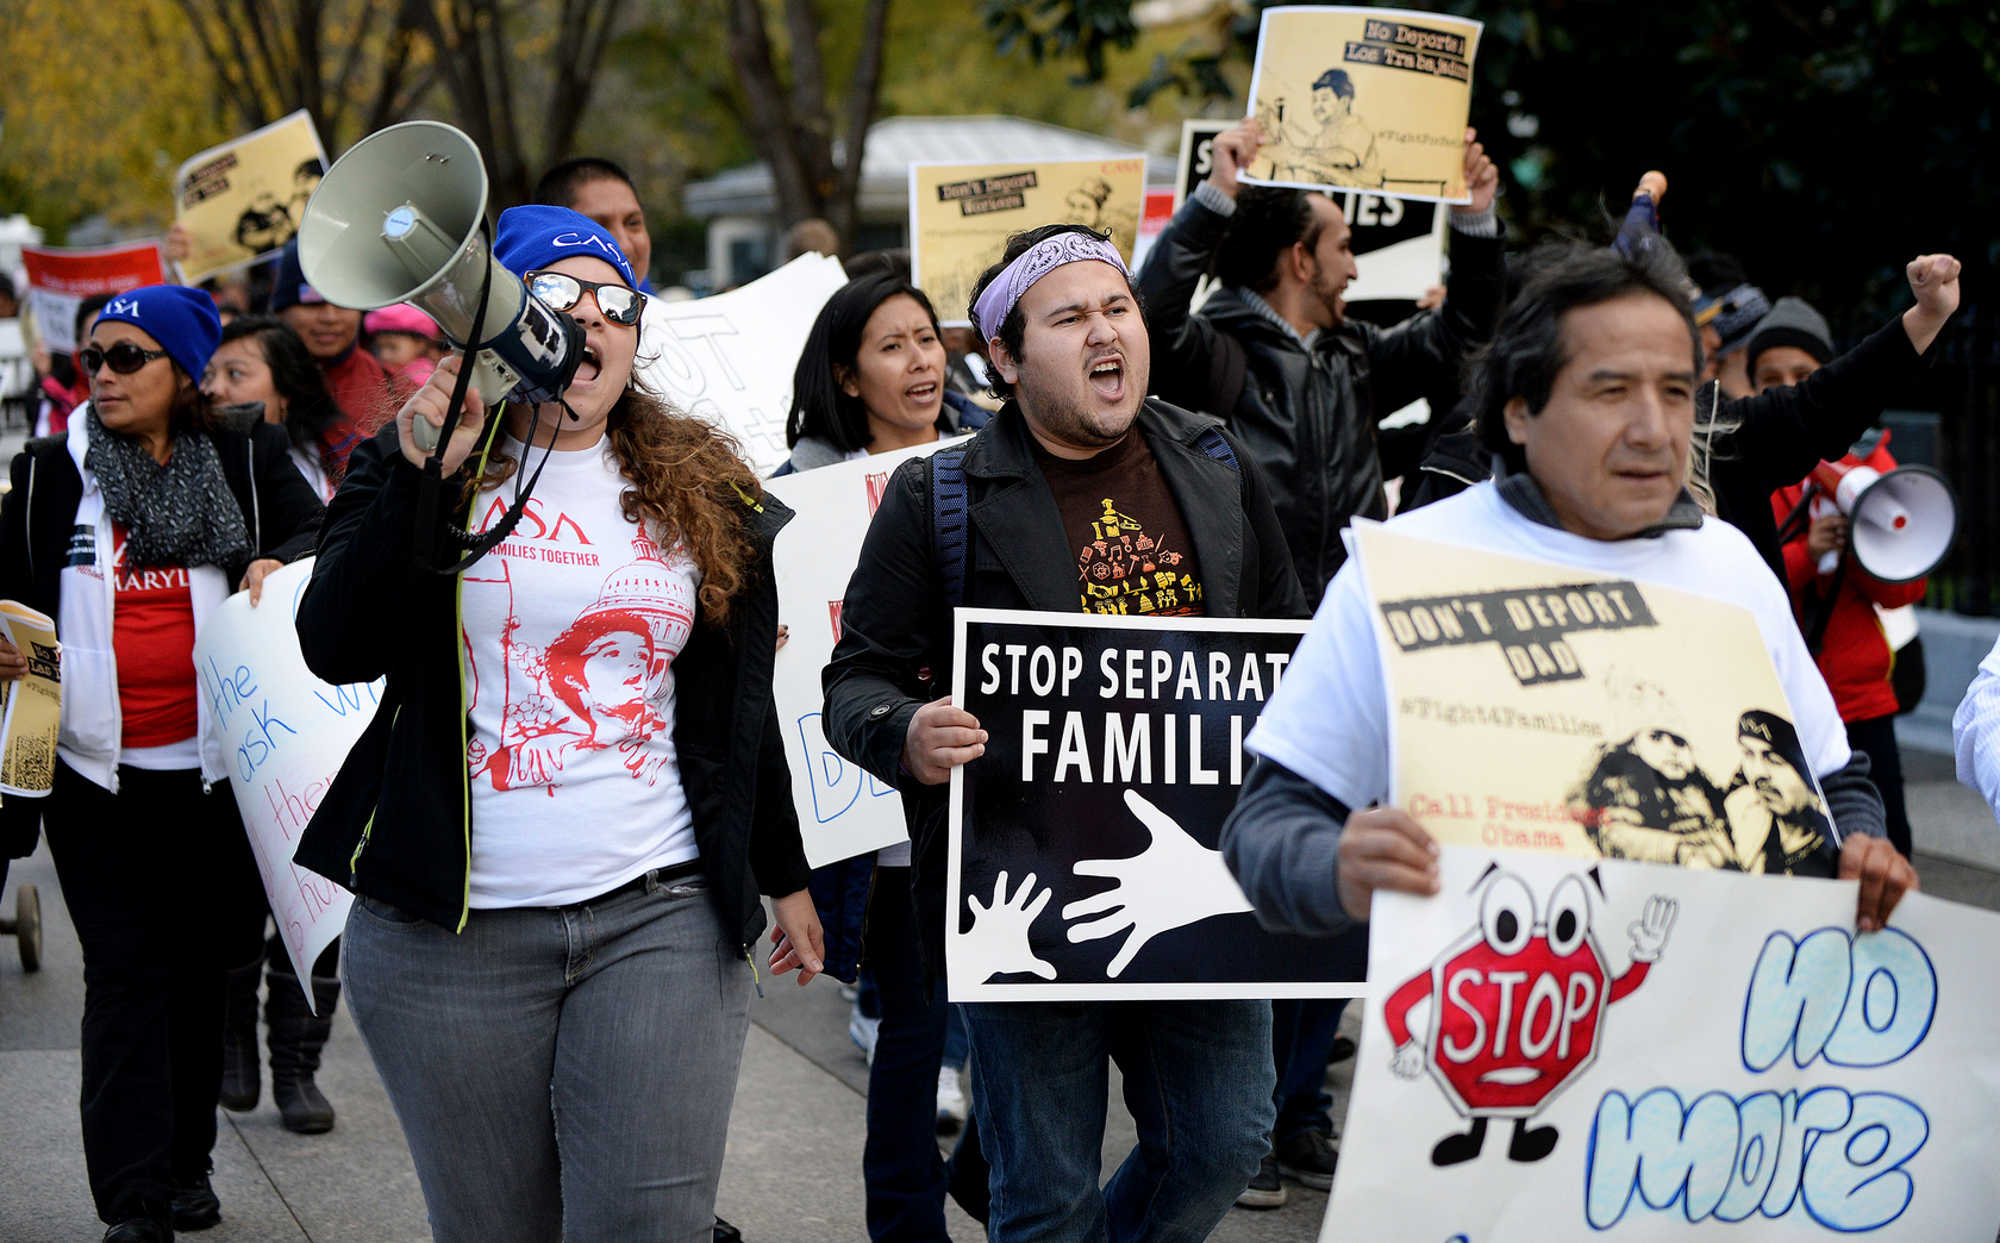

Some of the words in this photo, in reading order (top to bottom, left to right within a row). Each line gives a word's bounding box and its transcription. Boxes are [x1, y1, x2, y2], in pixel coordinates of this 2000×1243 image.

[1367, 21, 1391, 40] No
[471, 495, 595, 546] ASA
[488, 543, 536, 561] AMILIES
[540, 549, 600, 567] TOGETHER
[1386, 599, 1493, 647] DON'T
[1504, 589, 1633, 632] DEPORT
[980, 642, 1083, 697] STOP
[1099, 648, 1290, 702] SEPARAT
[1505, 640, 1578, 680] DAD
[202, 655, 258, 731] the
[1400, 697, 1604, 737] #Fight4Families
[236, 700, 297, 783] ask
[1021, 709, 1262, 785] FAMILI
[1409, 792, 1475, 820] Call
[1482, 822, 1566, 849] Obama
[1442, 968, 1597, 1064] STOP
